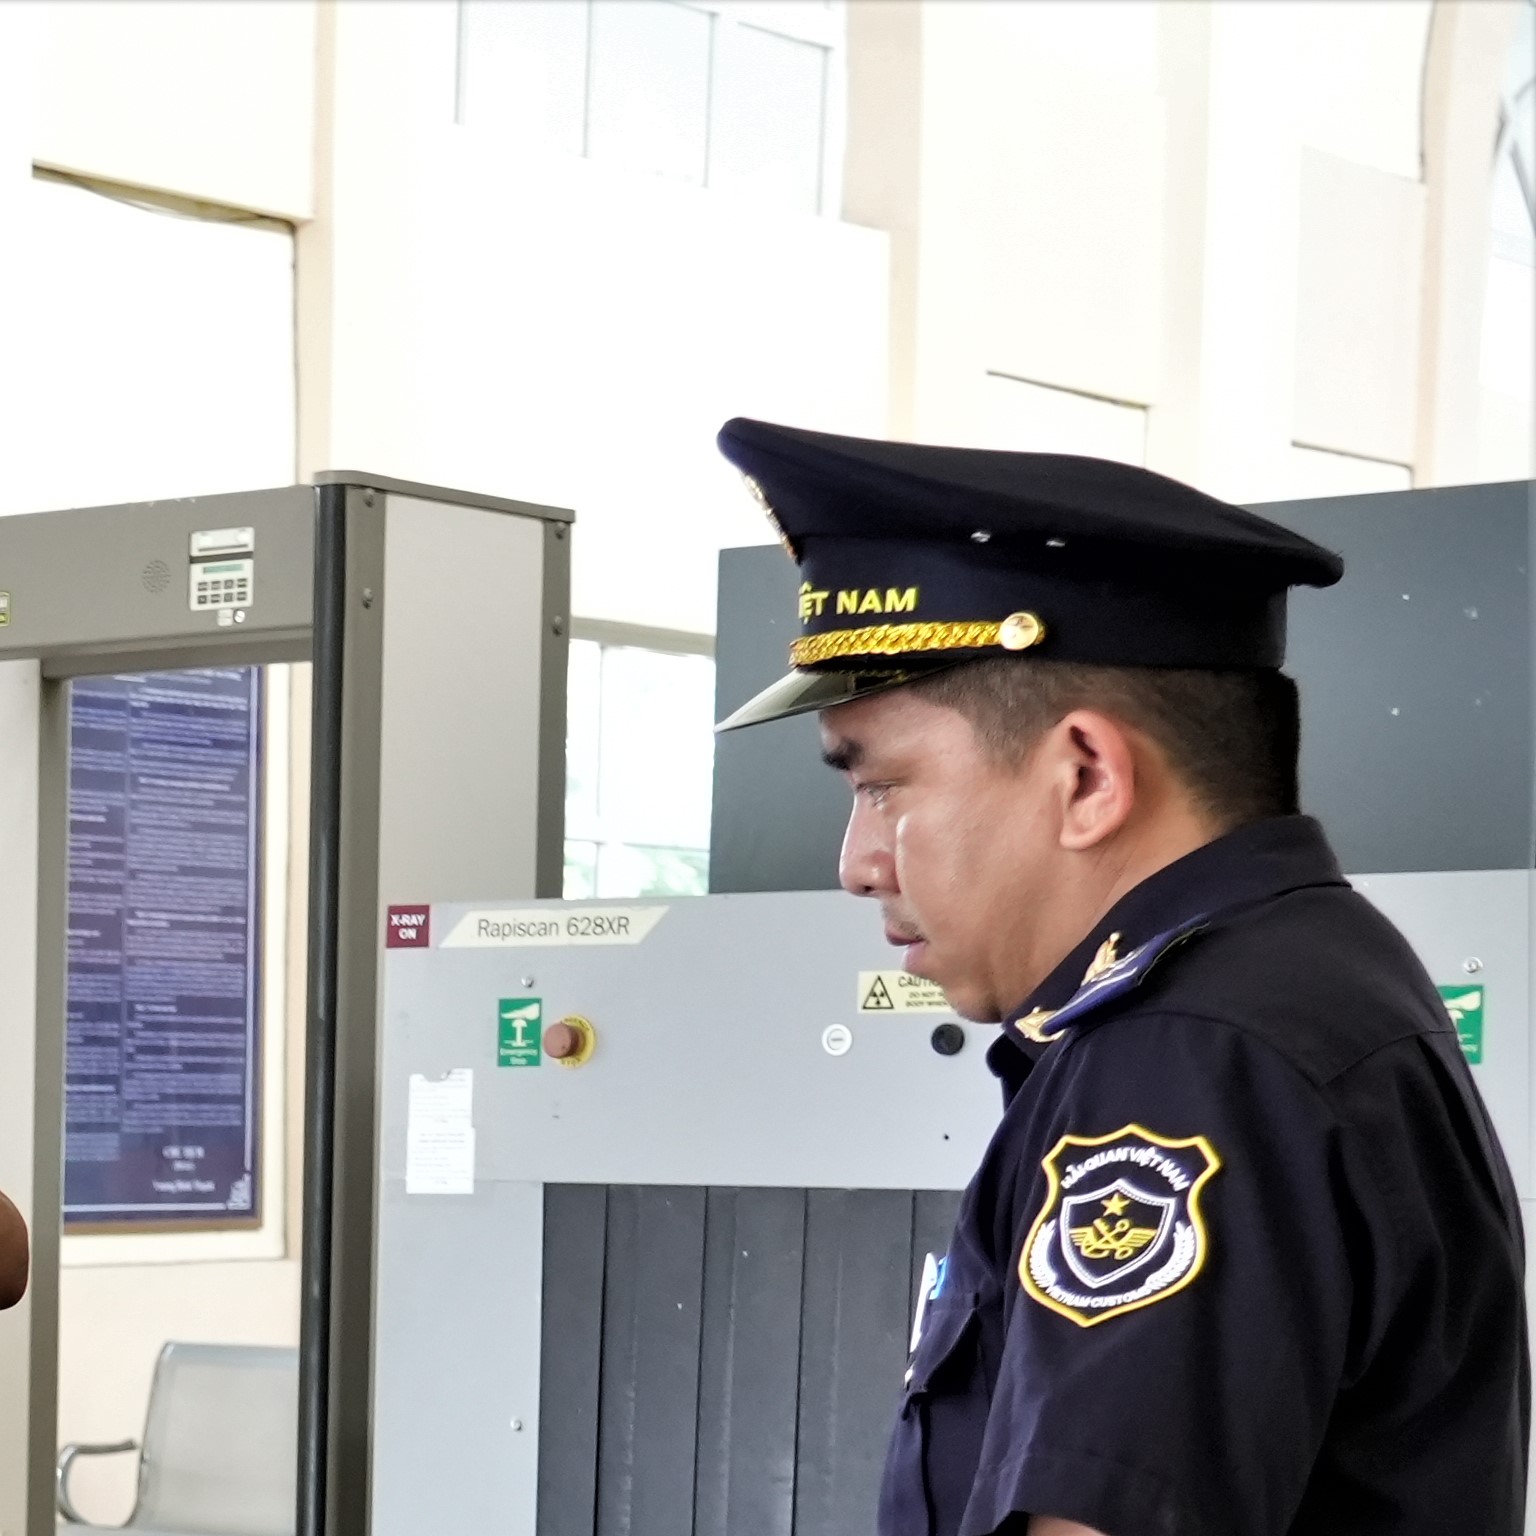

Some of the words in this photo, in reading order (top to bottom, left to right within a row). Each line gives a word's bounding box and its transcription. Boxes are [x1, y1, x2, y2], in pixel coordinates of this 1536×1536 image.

[836, 587, 918, 615] NAM
[390, 913, 426, 927] X-RAY
[477, 917, 559, 942] Rapiscan
[566, 915, 631, 937] 628XR
[398, 928, 417, 940] ON
[1084, 1147, 1129, 1172] QUAN
[1129, 1145, 1163, 1168] VIỆT
[1156, 1158, 1191, 1192] NAM
